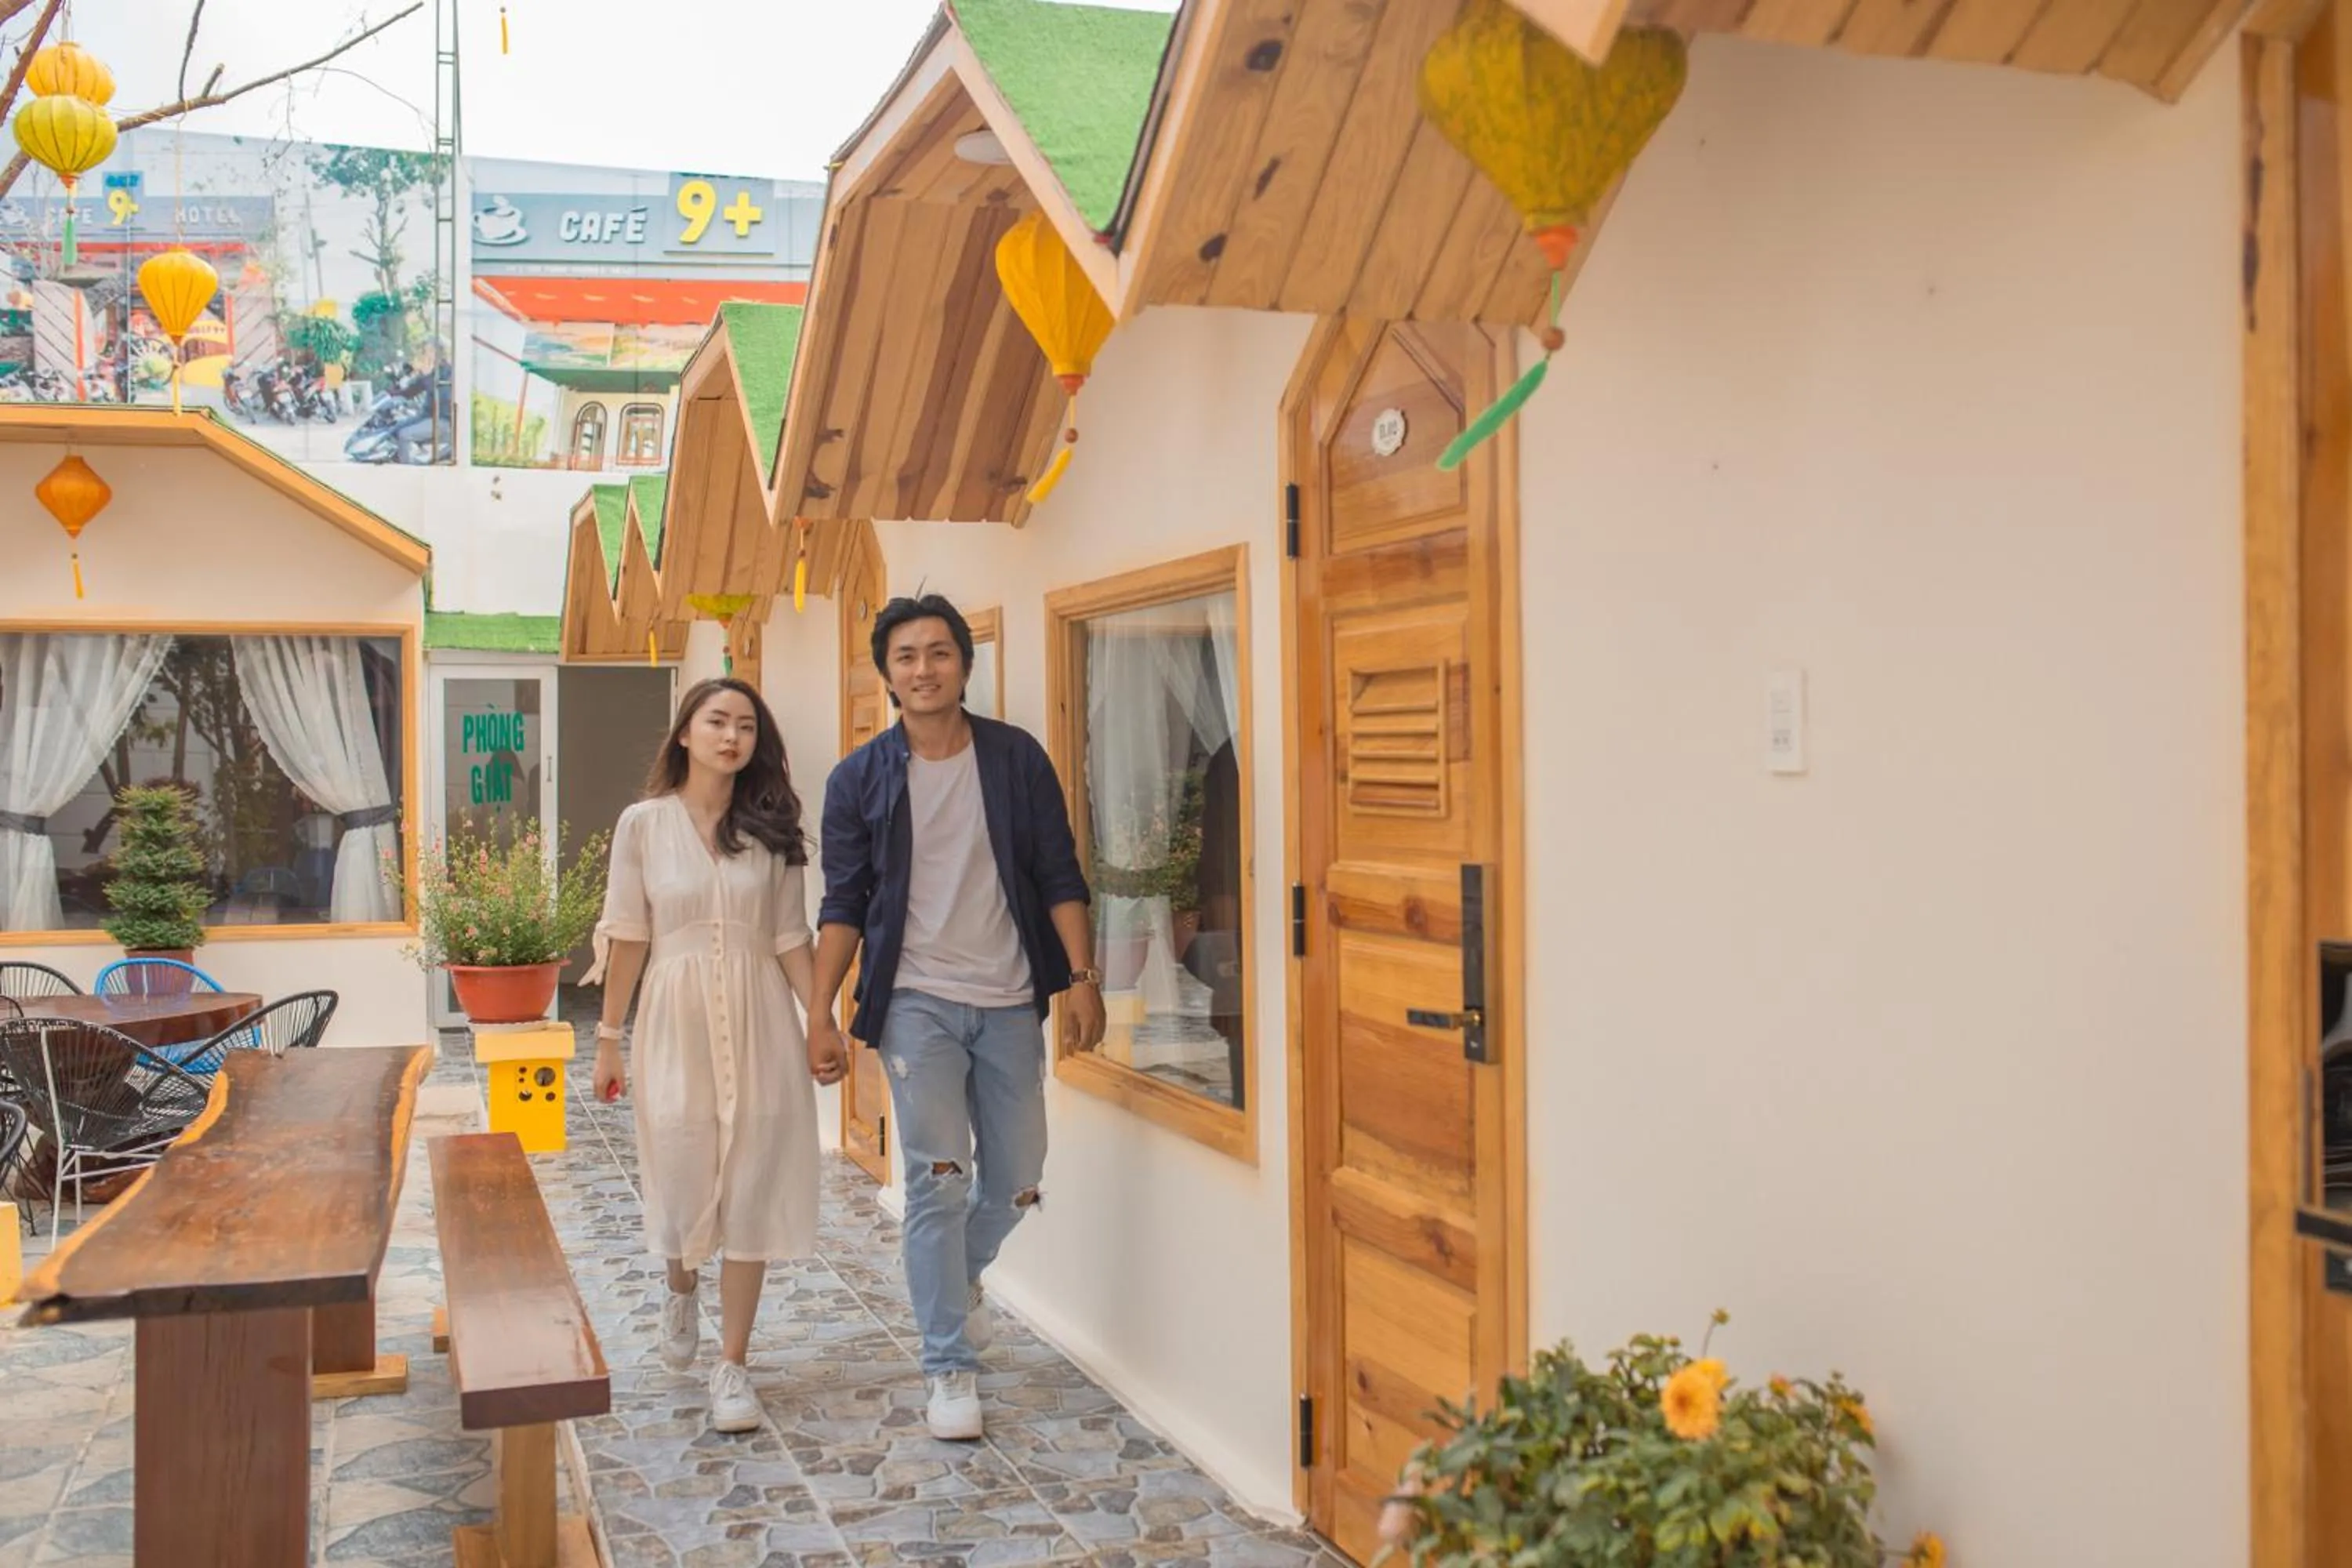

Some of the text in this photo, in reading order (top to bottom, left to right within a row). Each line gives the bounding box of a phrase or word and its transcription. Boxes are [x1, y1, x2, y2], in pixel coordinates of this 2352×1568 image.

[176, 206, 241, 226] HOTEL
[559, 180, 762, 245] CAFÉ 9+
[463, 702, 524, 753] PHÒNG
